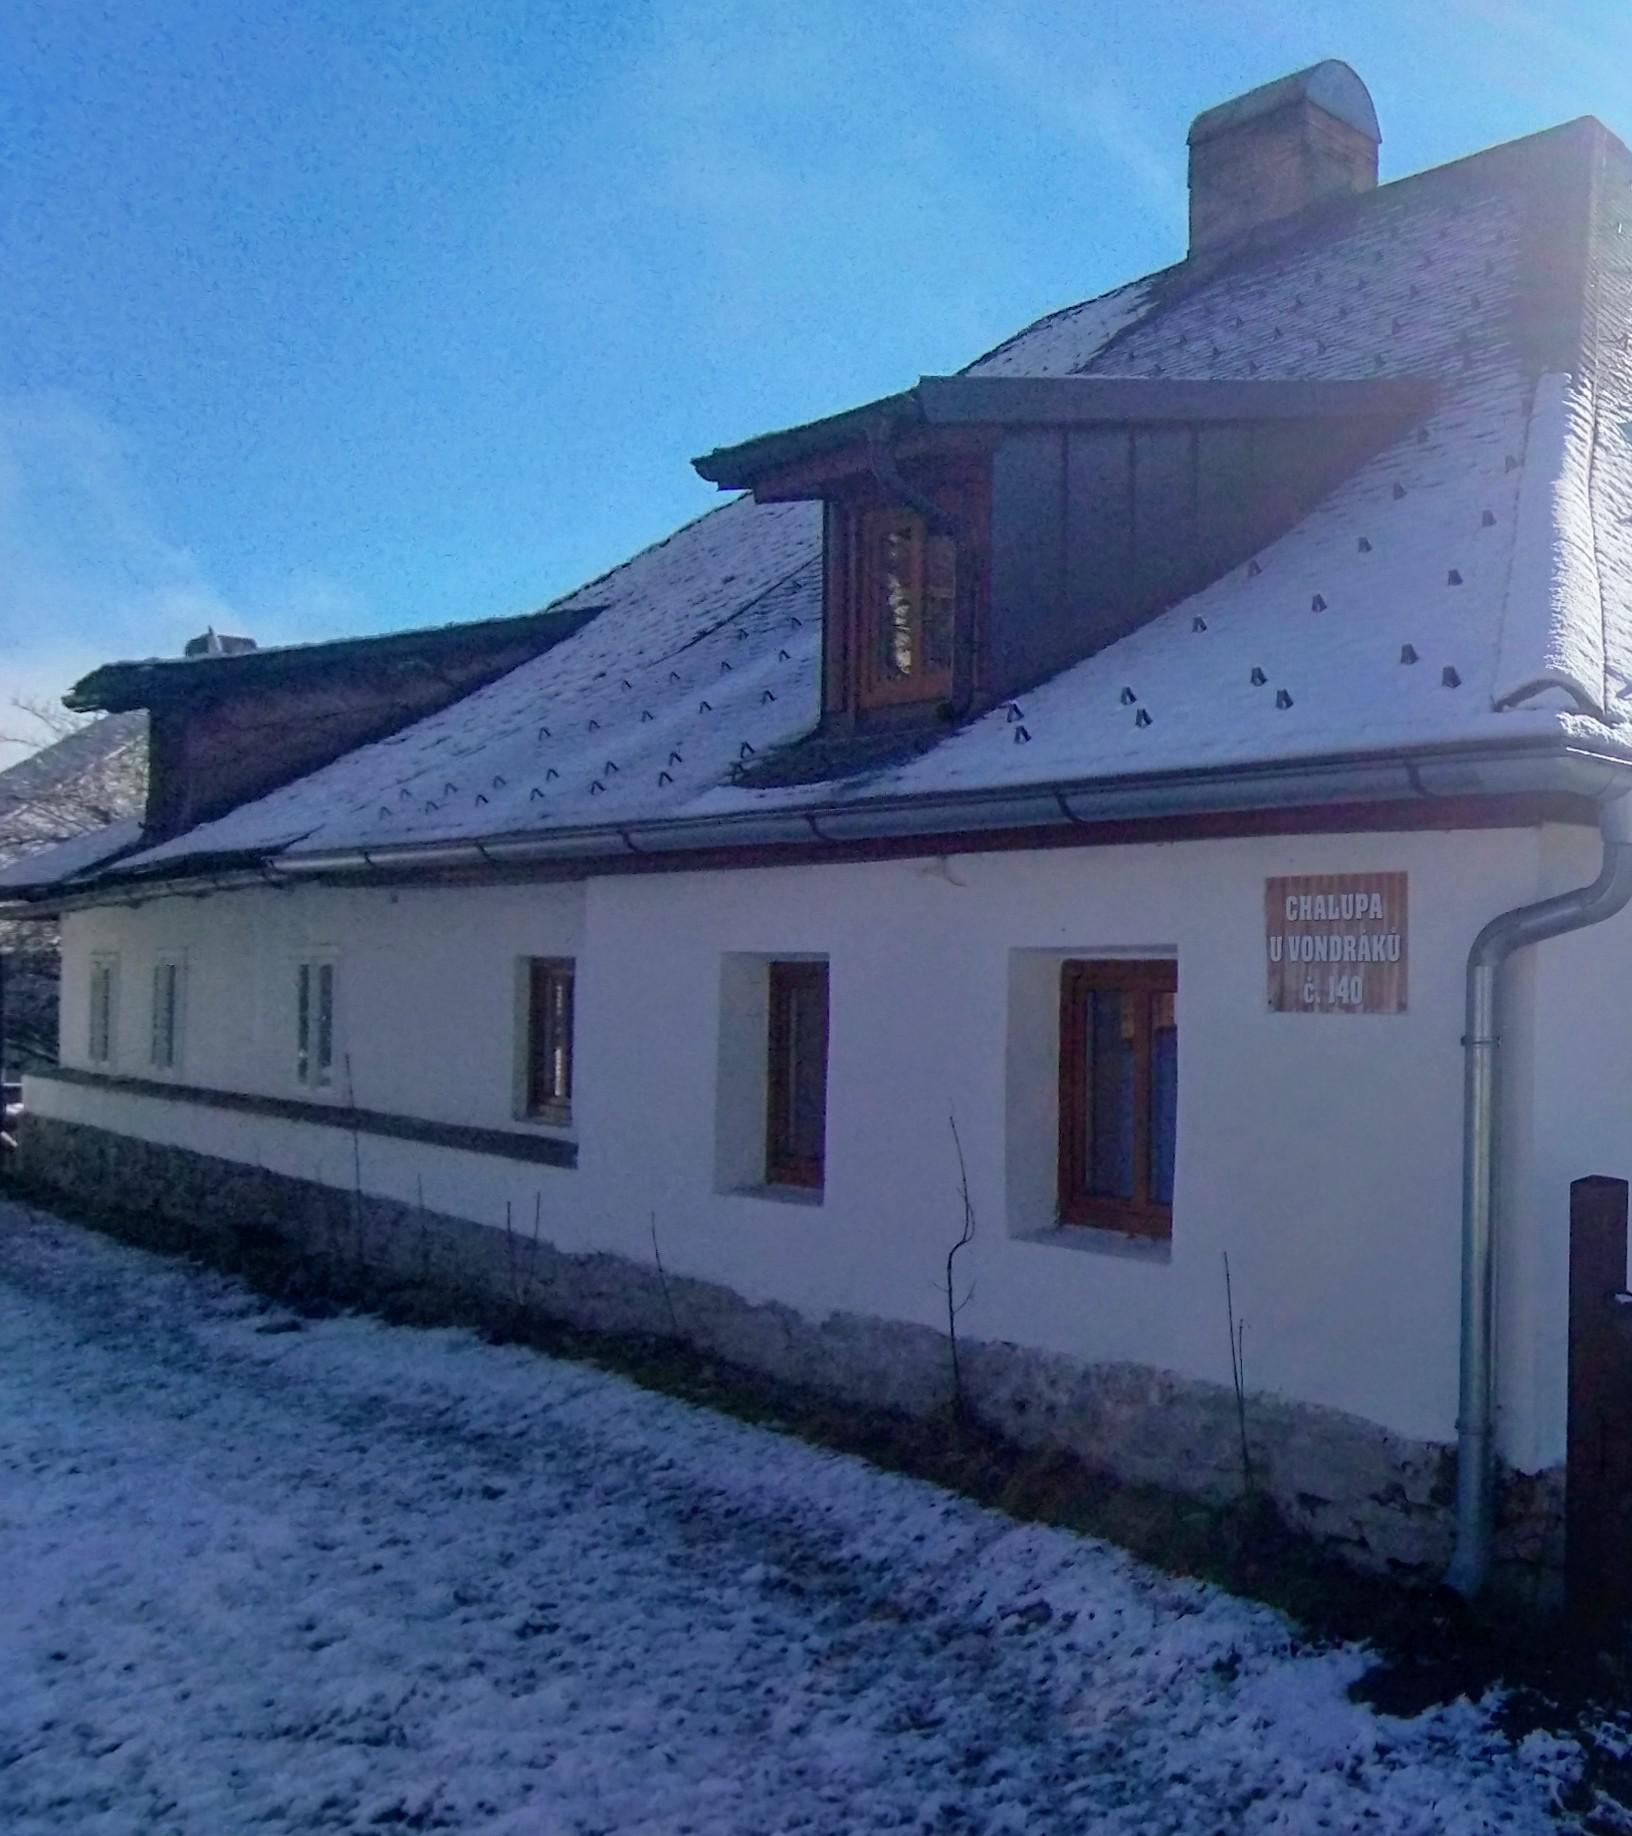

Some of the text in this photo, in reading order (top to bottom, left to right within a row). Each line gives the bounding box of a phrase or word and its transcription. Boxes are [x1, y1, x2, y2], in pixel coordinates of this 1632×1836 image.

[1286, 893, 1384, 921] CHALUPA
[1270, 927, 1401, 962] U VONDRÁKŮ
[1328, 975, 1363, 1004] 140
